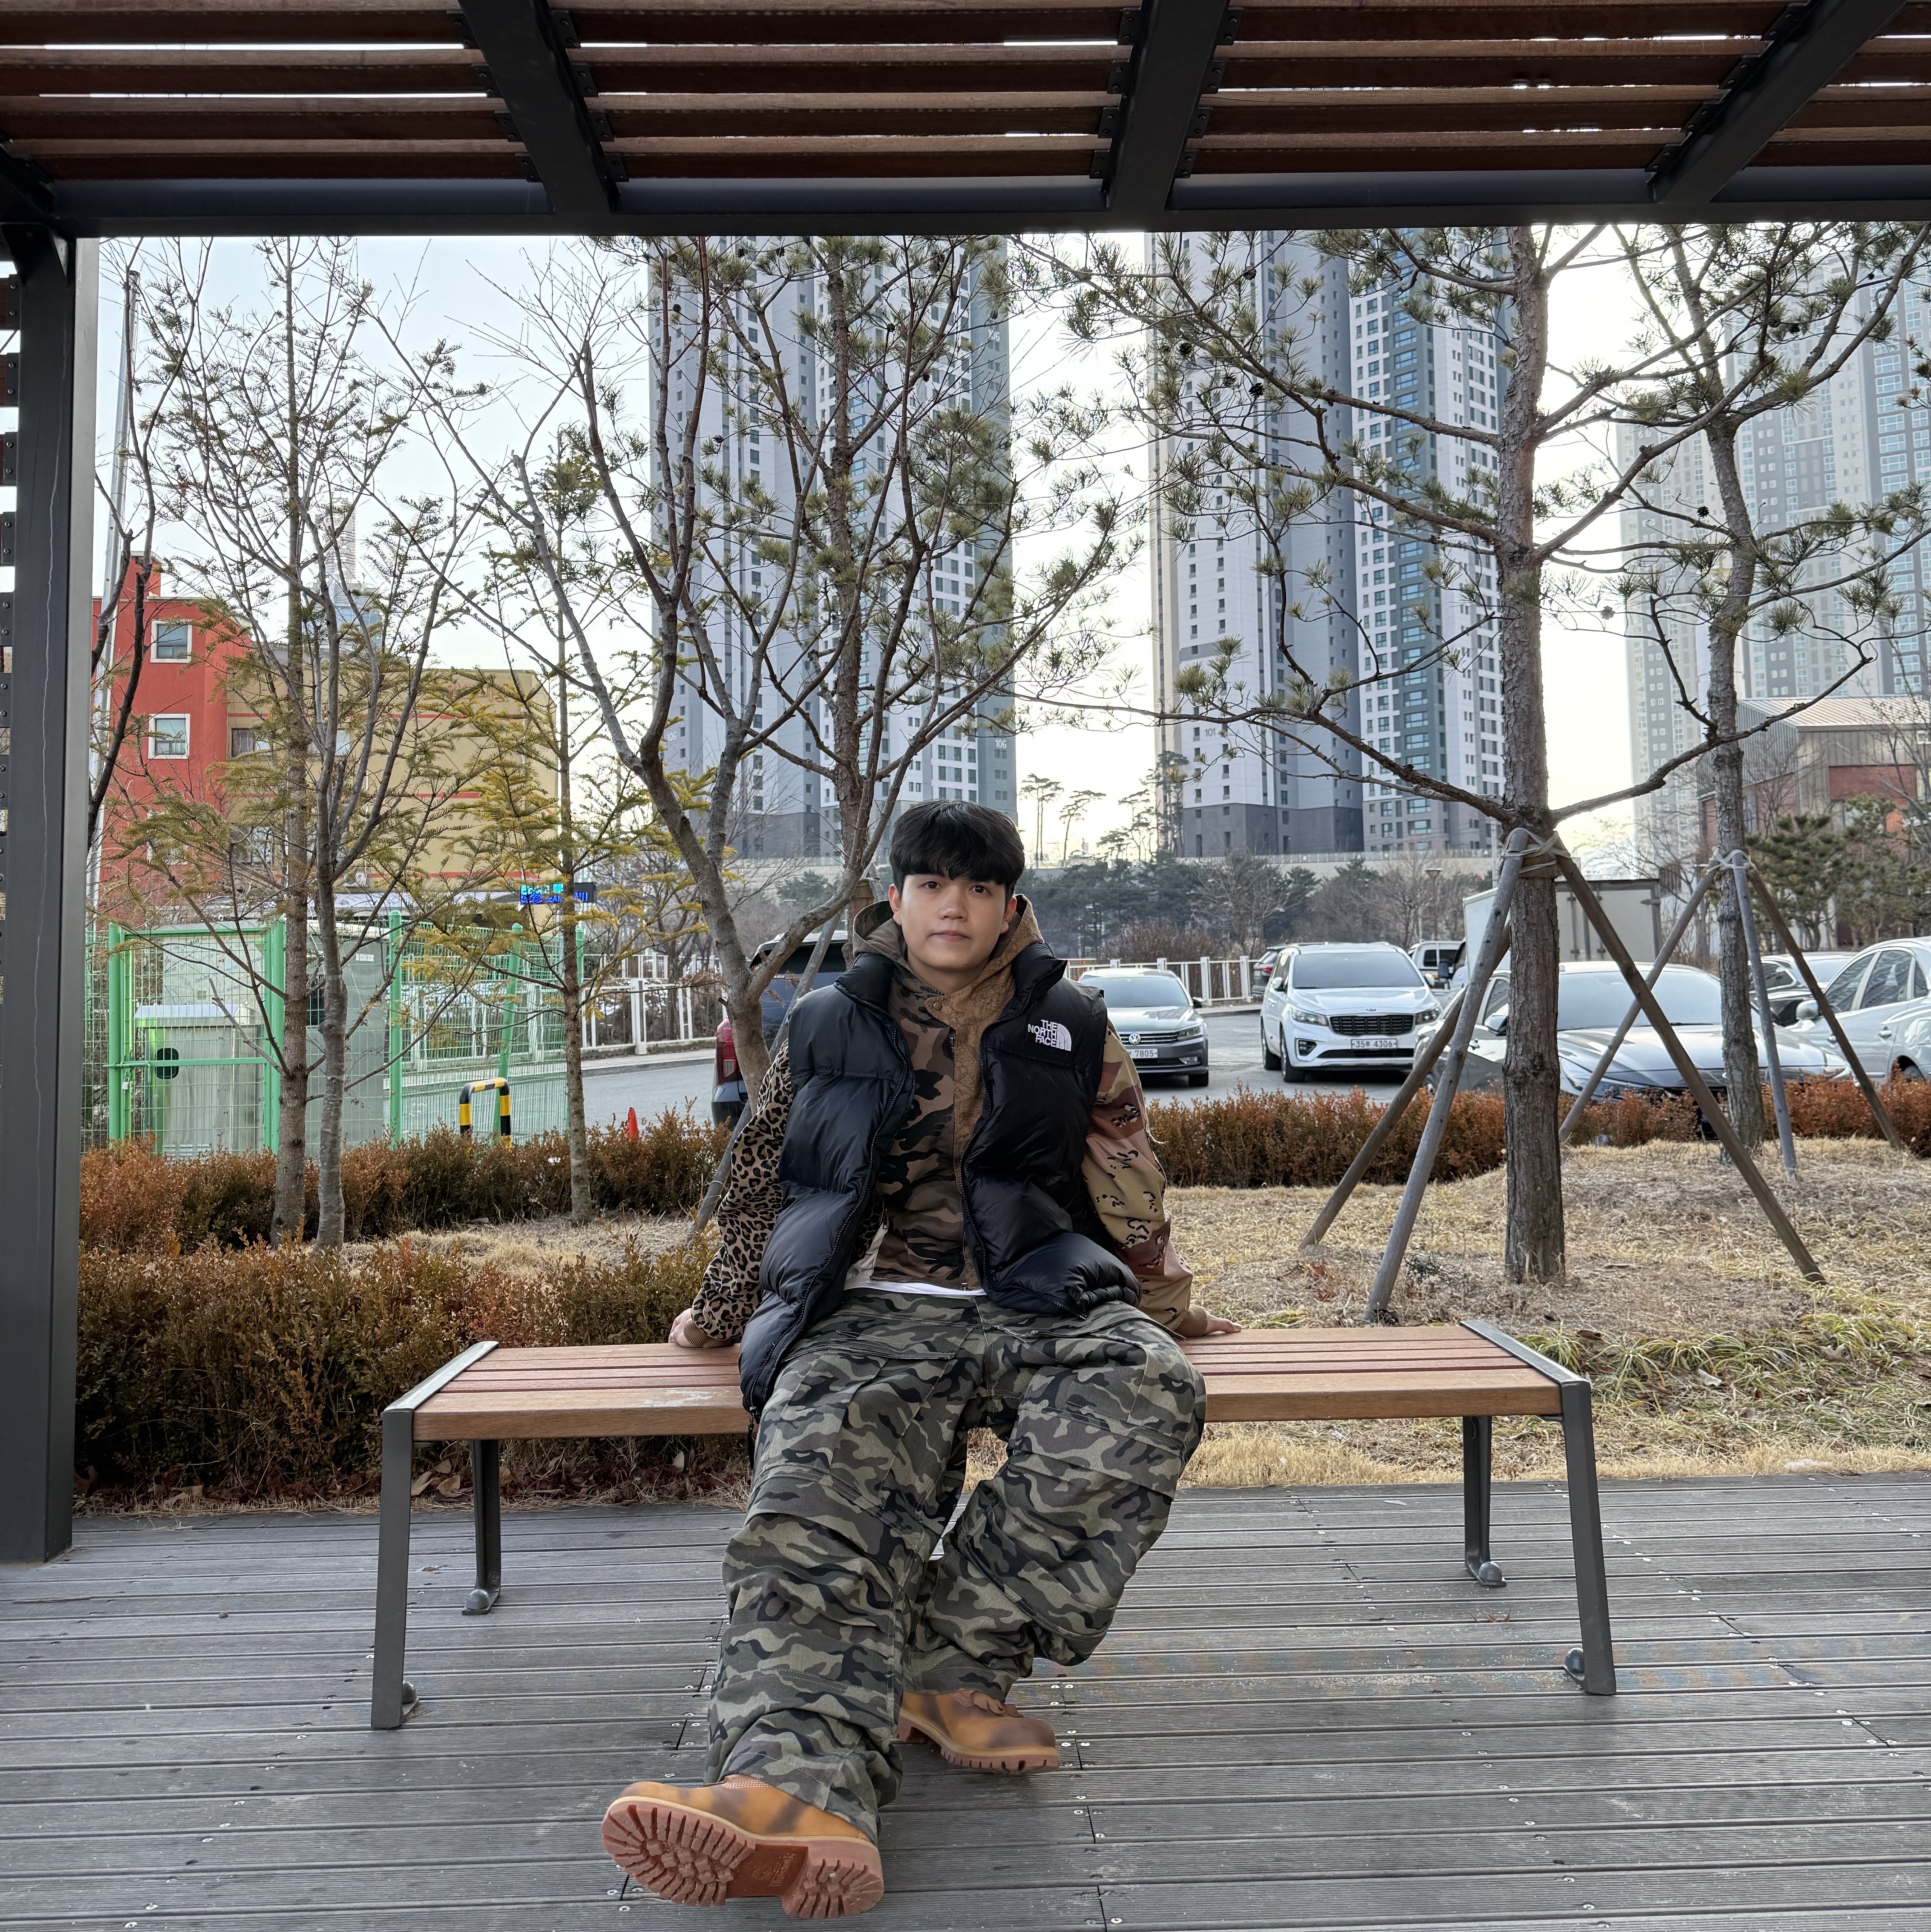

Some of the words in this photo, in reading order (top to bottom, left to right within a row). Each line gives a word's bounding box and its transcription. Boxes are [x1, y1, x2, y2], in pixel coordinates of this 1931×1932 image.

[988, 329, 1000, 341] 106
[667, 731, 677, 742] 106
[1205, 728, 1215, 737] 101
[995, 739, 1006, 748] 106
[1041, 1019, 1057, 1031] THE
[1028, 1024, 1057, 1039] NORTH
[1036, 1034, 1056, 1047] FACE
